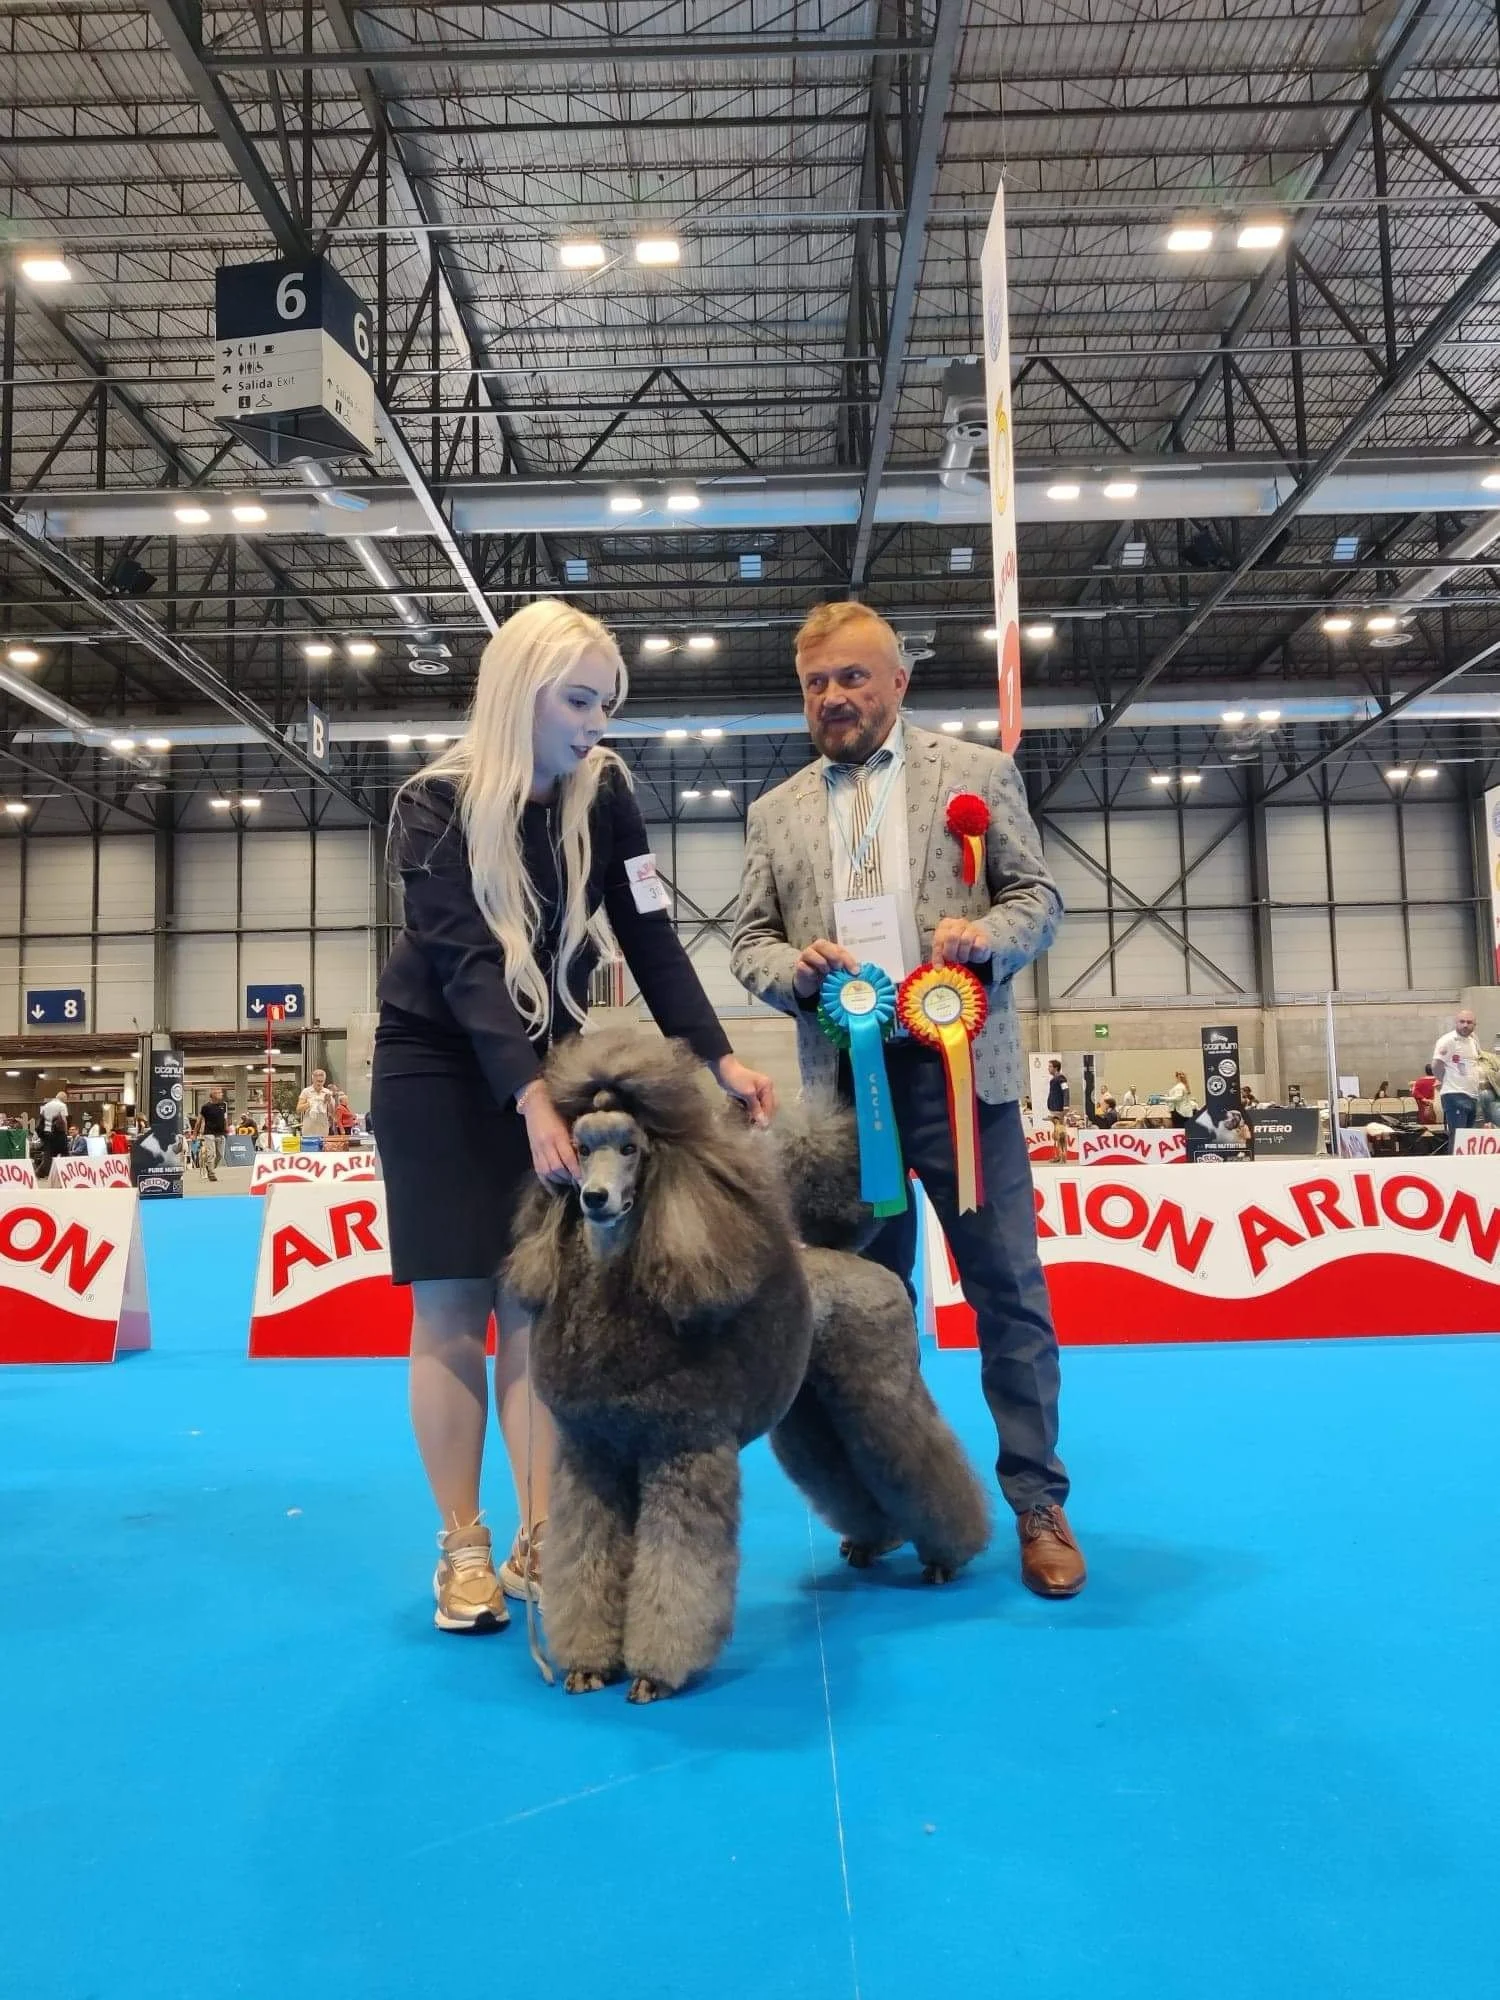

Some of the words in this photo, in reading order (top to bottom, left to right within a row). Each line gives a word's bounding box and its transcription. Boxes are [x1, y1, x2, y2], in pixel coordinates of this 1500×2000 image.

[276, 272, 307, 320] 6
[354, 312, 370, 360] 6
[238, 378, 273, 391] Salida
[277, 376, 296, 387] Exit
[313, 714, 325, 759] B
[64, 999, 78, 1018] 8
[284, 993, 298, 1013] 8
[1083, 1133, 1152, 1159] ARION
[1456, 1136, 1500, 1156] RIO
[61, 1161, 97, 1187] ARION
[256, 1156, 327, 1180] ARION
[1238, 1174, 1500, 1278] ARION
